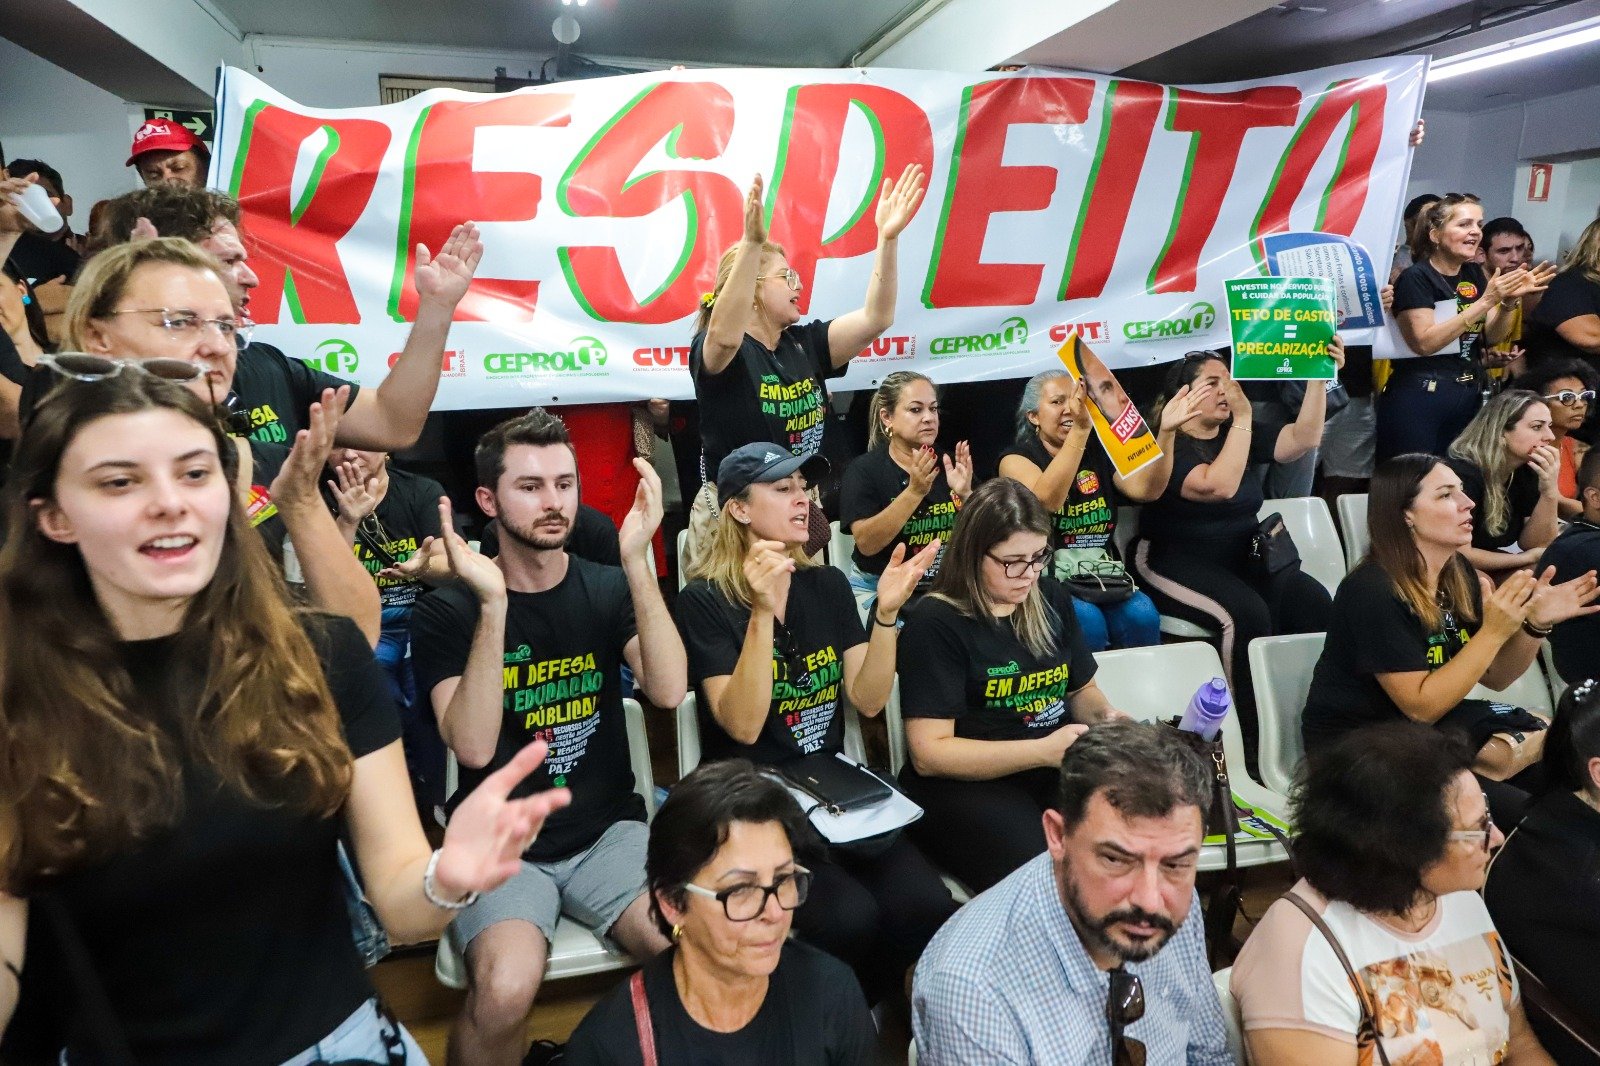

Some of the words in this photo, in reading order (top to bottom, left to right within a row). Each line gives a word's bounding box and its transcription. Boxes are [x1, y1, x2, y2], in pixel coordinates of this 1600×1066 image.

[229, 78, 1388, 324] RESPEITO
[1231, 283, 1268, 292] INVESTIR
[1232, 309, 1270, 321] TETO
[1274, 309, 1291, 321] DE
[1049, 321, 1102, 342] CUT
[1122, 317, 1193, 340] CEPROL
[929, 333, 1007, 355] CEPROL
[483, 350, 582, 373] CEPROL
[633, 346, 691, 366] CUT
[760, 383, 781, 400] EM
[1427, 646, 1443, 664] EM
[503, 666, 519, 689] M
[527, 653, 596, 686] DEFESA
[985, 678, 1013, 698] EM
[1018, 664, 1069, 694] DEFESA
[514, 671, 604, 712] EDUCAÇÃO
[557, 739, 588, 756] RESPEITO
[548, 761, 571, 774] PAZ
